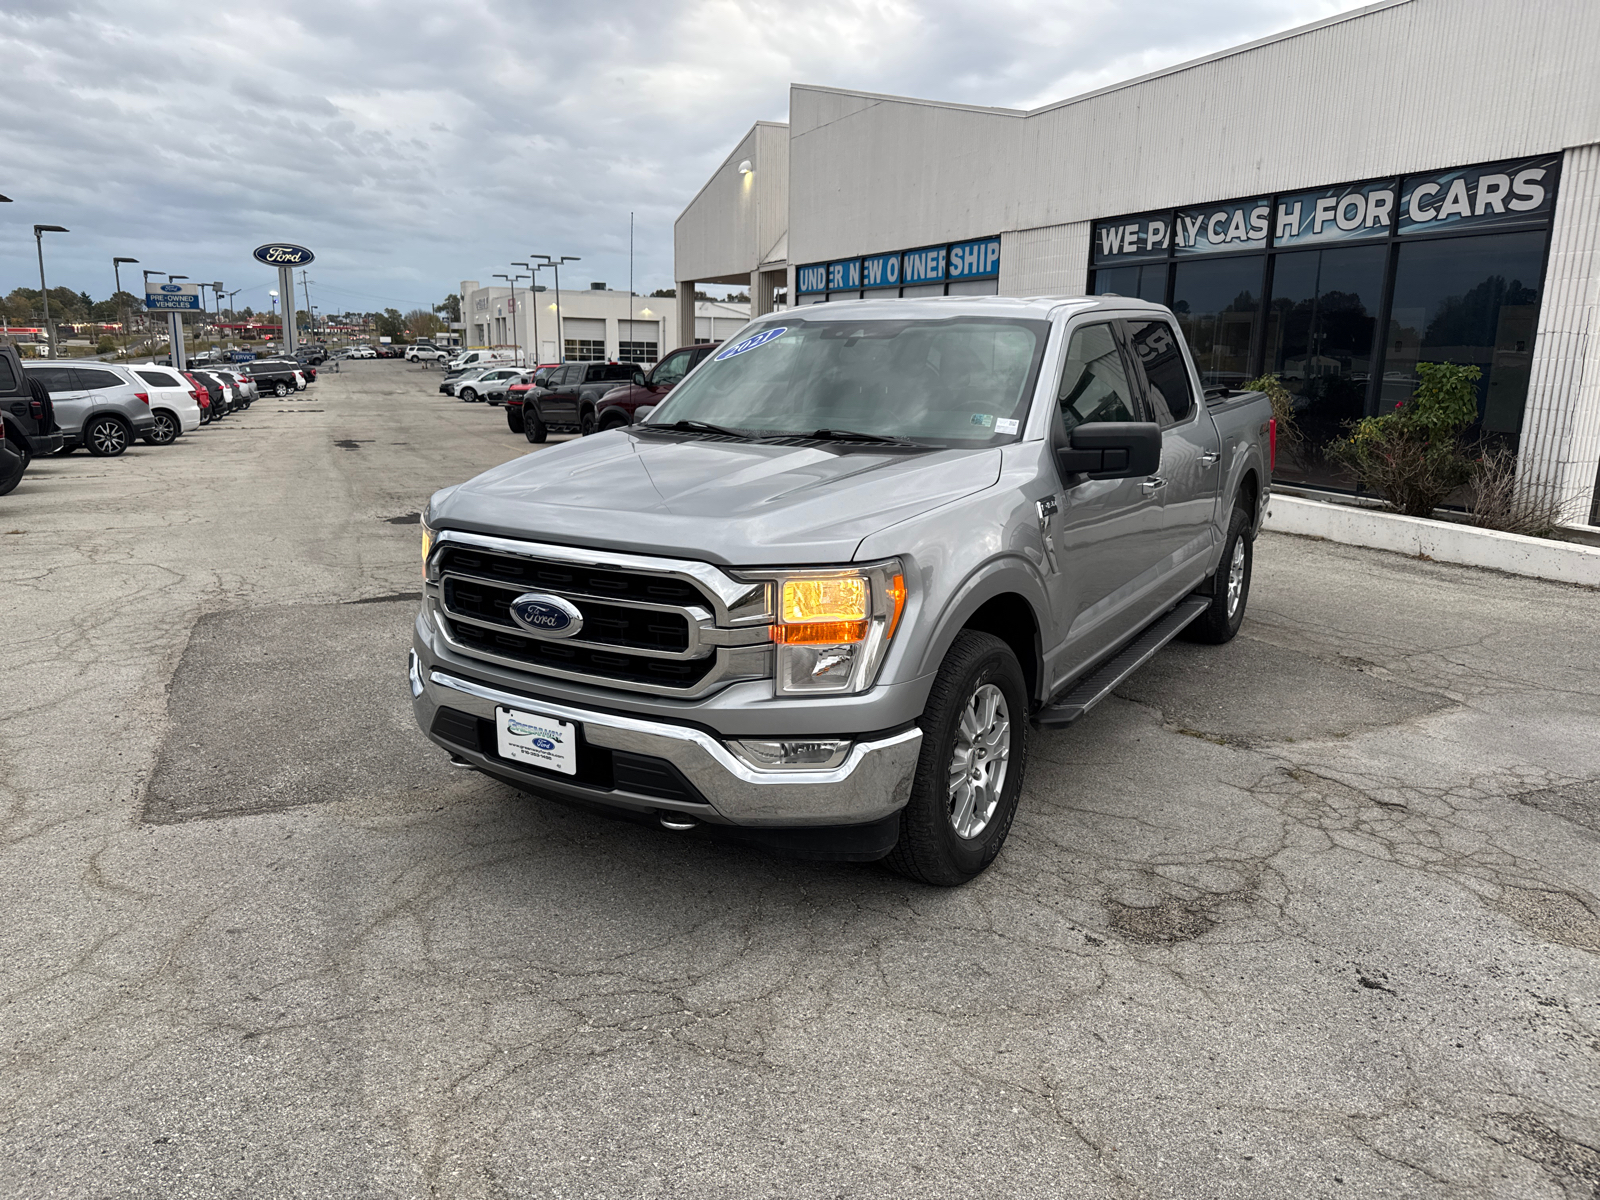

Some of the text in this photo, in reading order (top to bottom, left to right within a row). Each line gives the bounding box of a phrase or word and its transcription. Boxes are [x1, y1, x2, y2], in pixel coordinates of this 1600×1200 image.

[1101, 168, 1547, 256] WE PAY CASH FOR CARS
[266, 247, 302, 262] Ford
[800, 242, 1000, 292] UNDER NEW OWNERSHIP
[155, 301, 190, 309] VEHICLES
[726, 330, 774, 359] 2021
[524, 604, 559, 627] Ford
[536, 738, 551, 749] Ford
